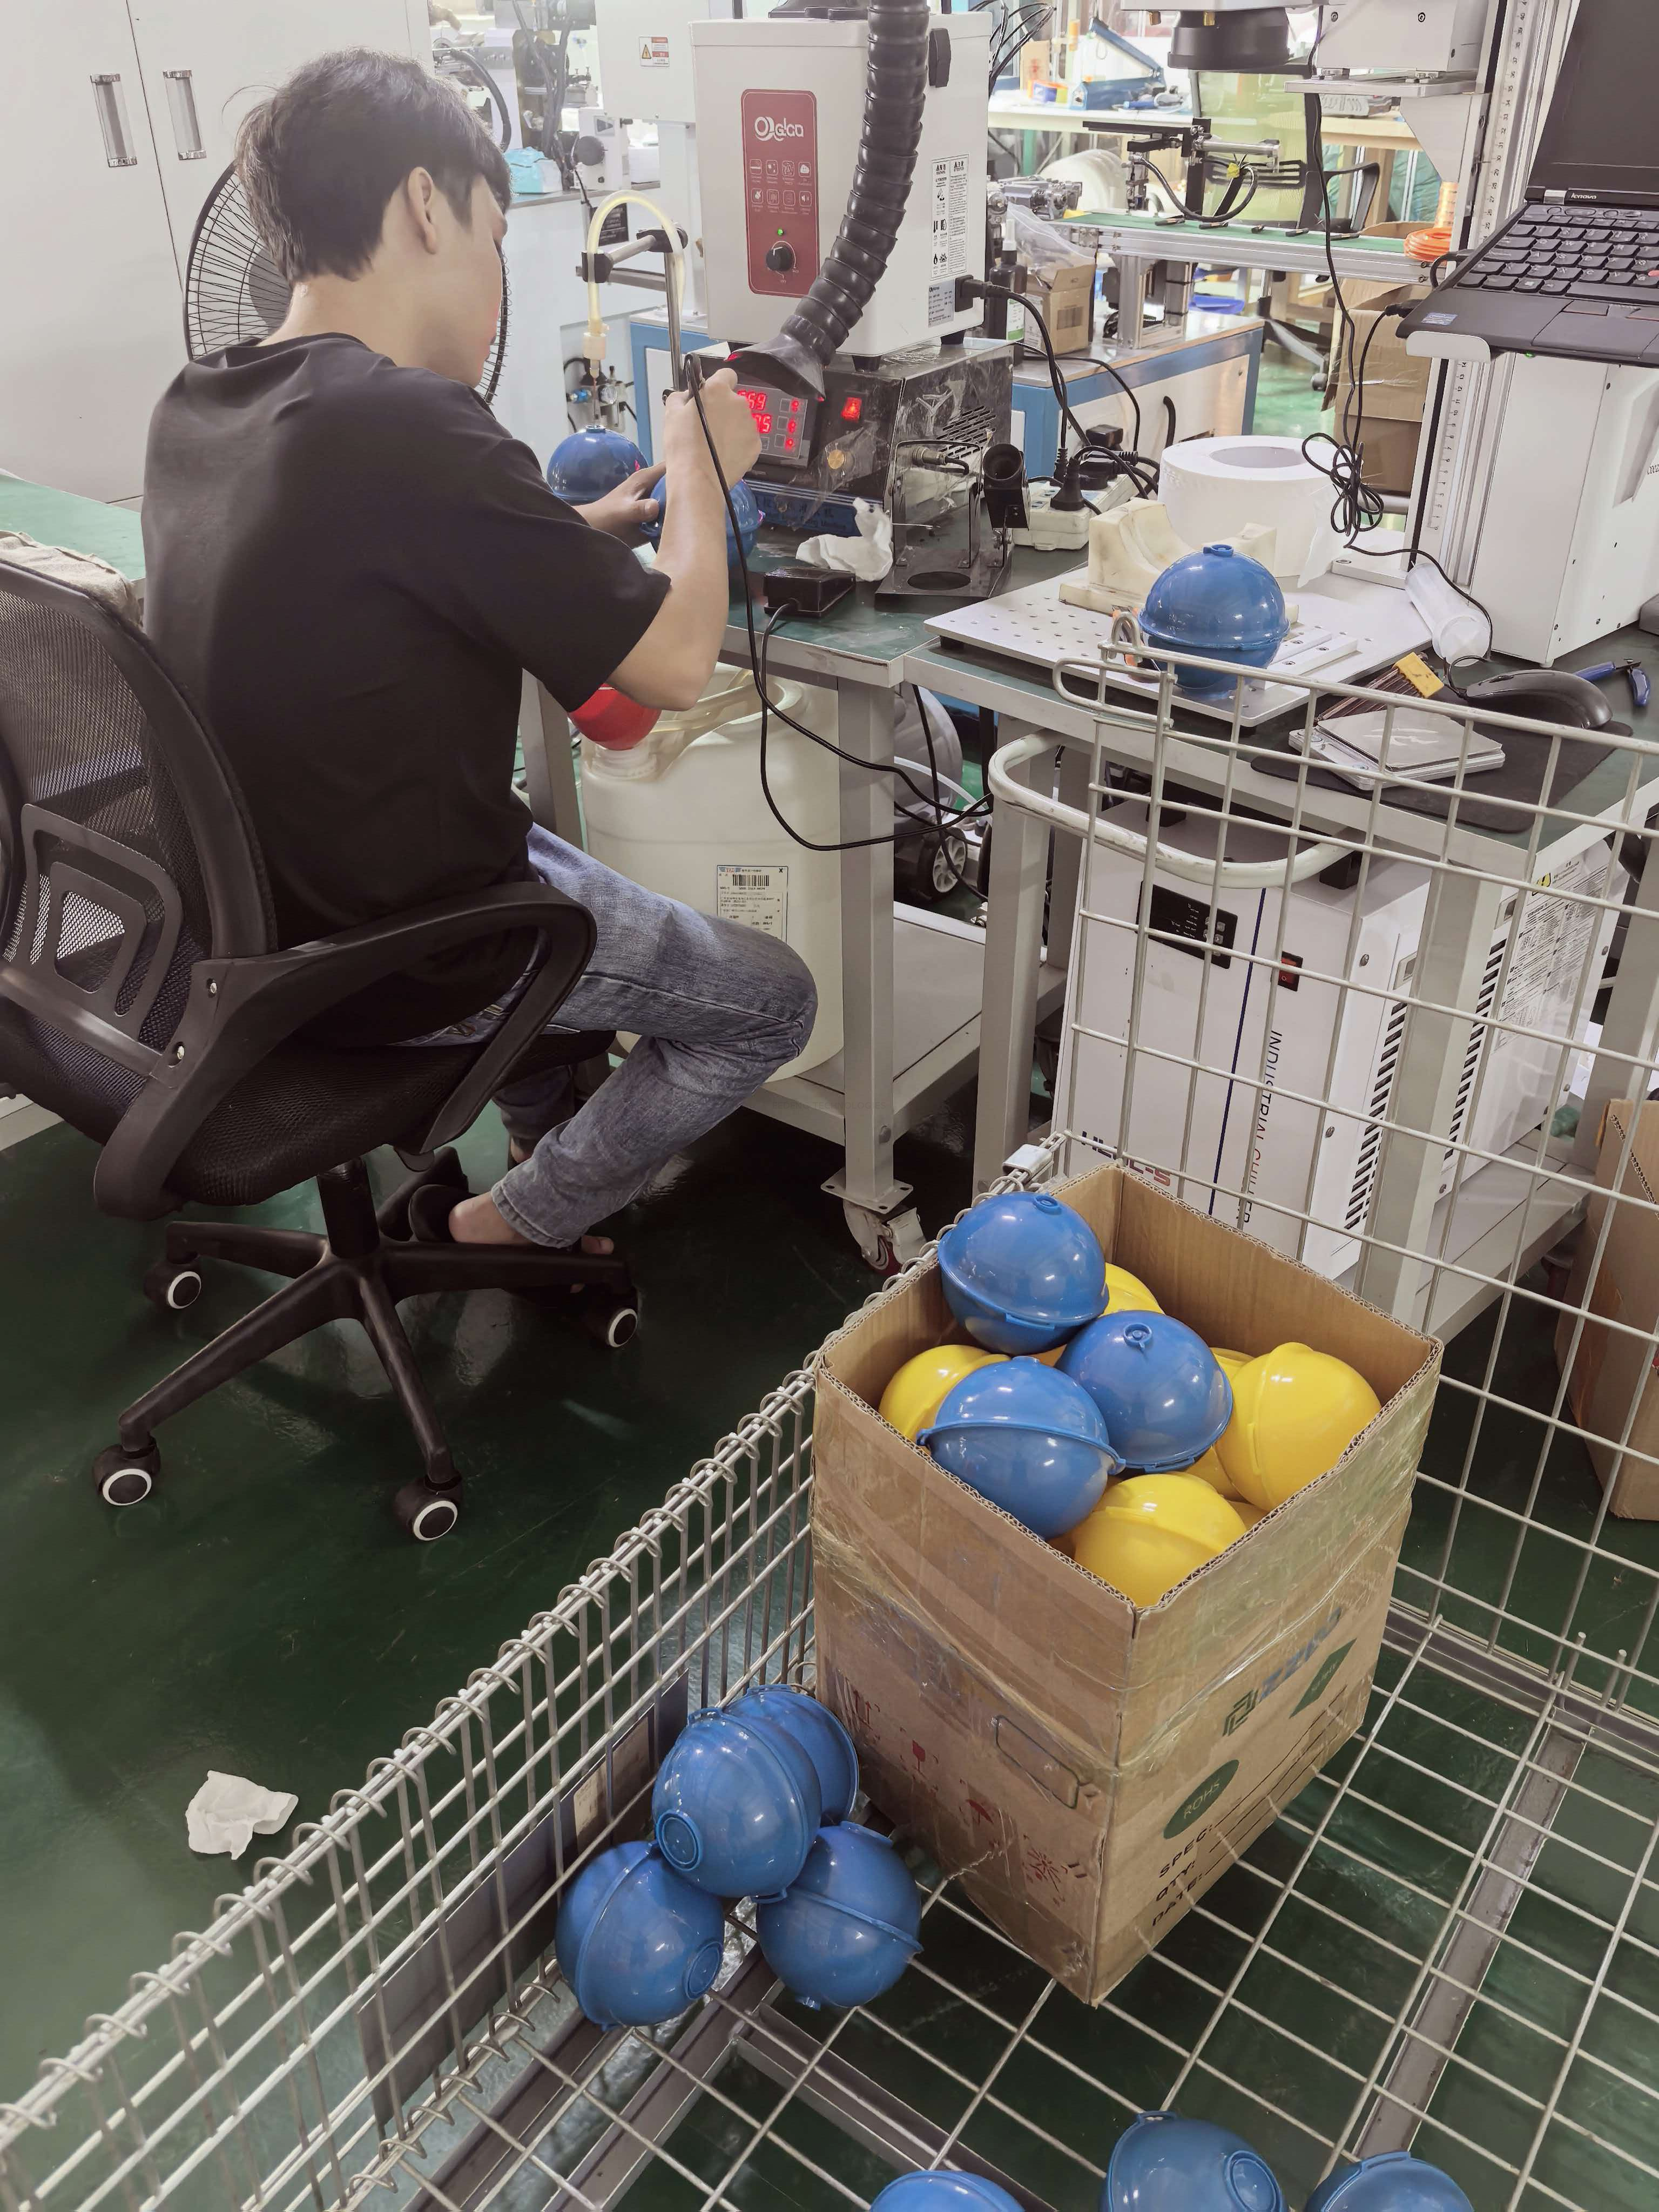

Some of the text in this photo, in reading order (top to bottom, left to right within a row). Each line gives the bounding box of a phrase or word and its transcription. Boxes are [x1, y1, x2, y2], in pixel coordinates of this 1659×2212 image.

[737, 389, 766, 410] 59
[1152, 1873, 1203, 1926] DATE:
[1156, 1860, 1195, 1901] QTY:
